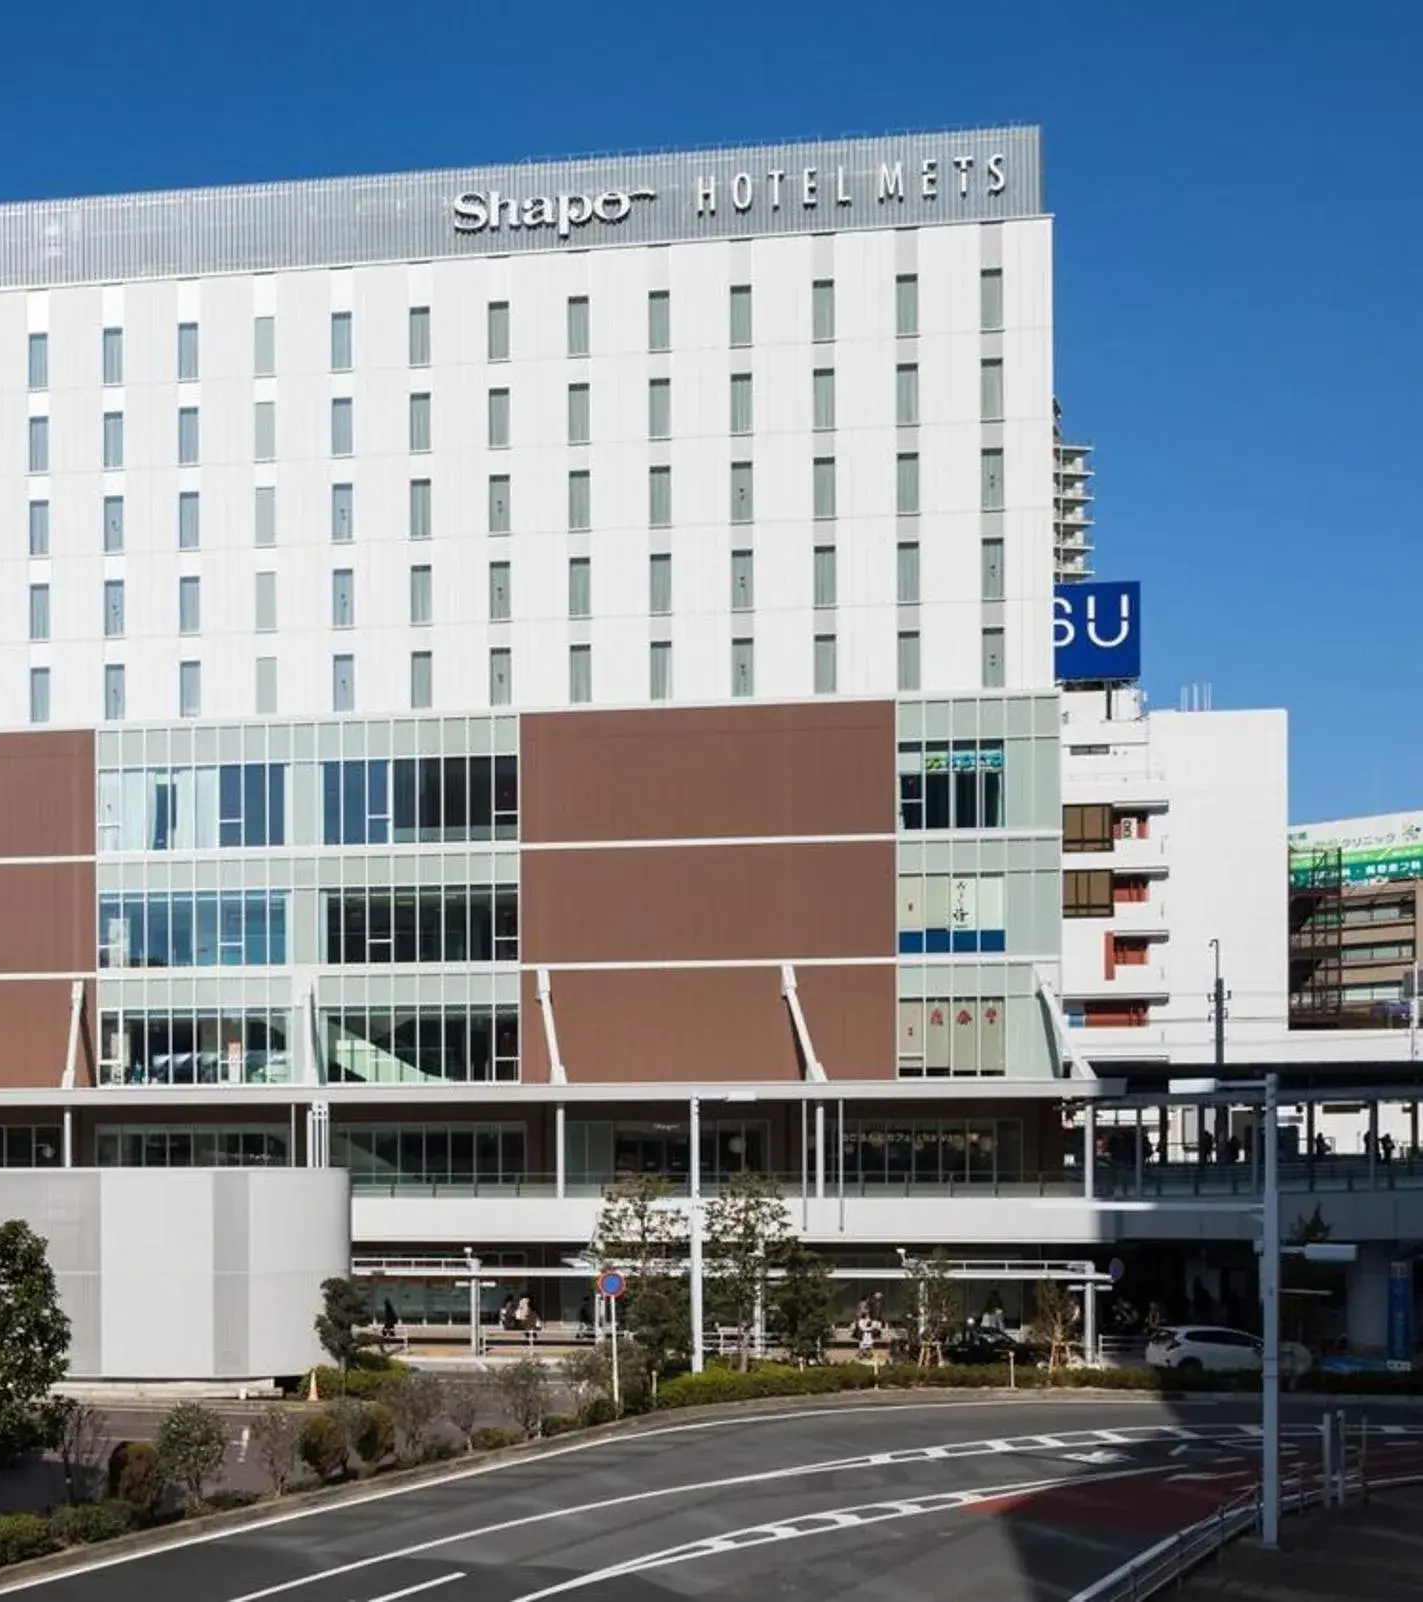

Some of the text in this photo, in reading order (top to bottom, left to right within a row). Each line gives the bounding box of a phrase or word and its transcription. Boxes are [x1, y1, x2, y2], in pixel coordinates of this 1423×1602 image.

[454, 153, 1005, 237] Shapo HOTEL METS
